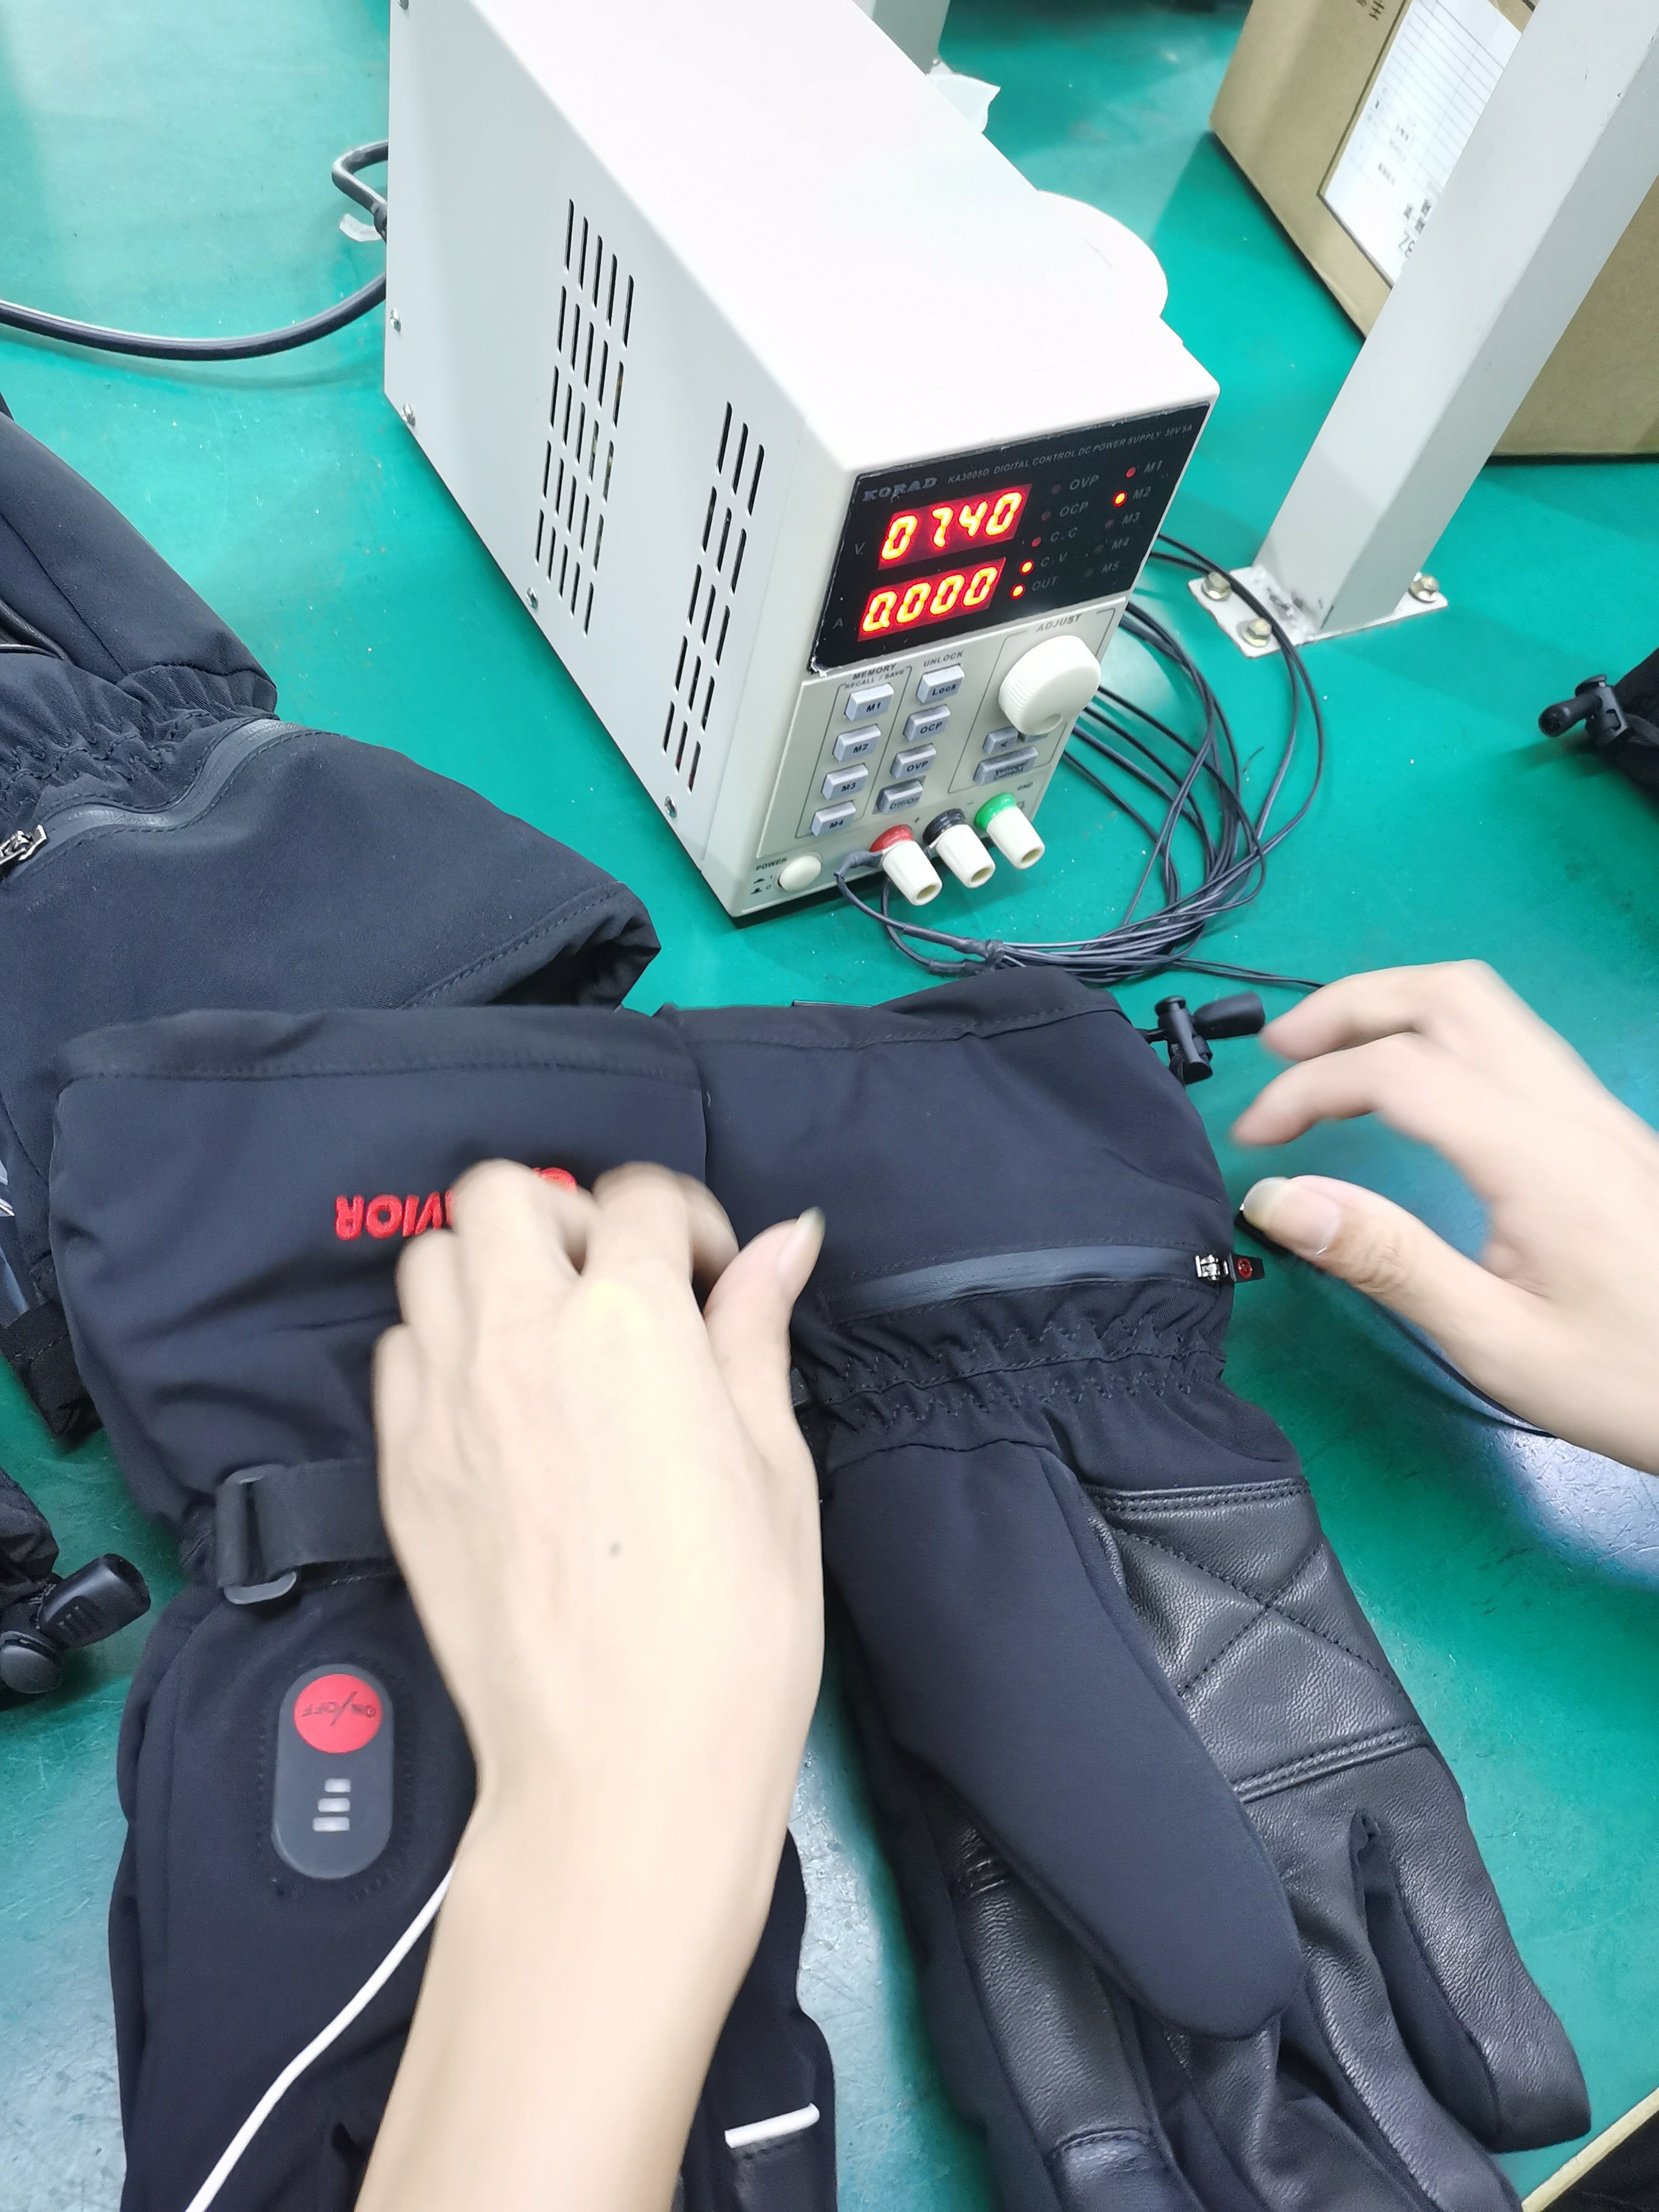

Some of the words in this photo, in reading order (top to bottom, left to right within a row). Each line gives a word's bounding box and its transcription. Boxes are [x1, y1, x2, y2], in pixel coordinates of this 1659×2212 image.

[993, 460, 1030, 475] DIGITAL
[1033, 450, 1075, 466] CONTROL
[1078, 447, 1091, 457] DC
[1092, 438, 1127, 452] POWER
[1127, 430, 1162, 445] SUPPLY
[1144, 460, 1164, 474] M1
[1069, 474, 1100, 491] OVP
[862, 477, 937, 503] KORAD
[1133, 486, 1151, 500] M2
[1059, 501, 1089, 517] OCP
[1122, 512, 1141, 525] M3
[1111, 537, 1130, 551] M4
[1101, 560, 1120, 574] M5
[1032, 576, 1057, 592] OUT
[832, 618, 844, 629] A
[1036, 613, 1083, 632] ADJUST
[923, 650, 964, 667] UNLOCK
[852, 663, 897, 681] MEMORY
[845, 676, 876, 690] RECALL
[884, 669, 905, 680] SAVE
[931, 683, 957, 696] Lock
[866, 702, 882, 713] M1
[920, 722, 943, 734] OCP
[853, 743, 869, 754] M2
[906, 760, 929, 773] OVP
[840, 782, 857, 793] M3
[829, 819, 844, 830] M4
[756, 857, 788, 871] POWER
